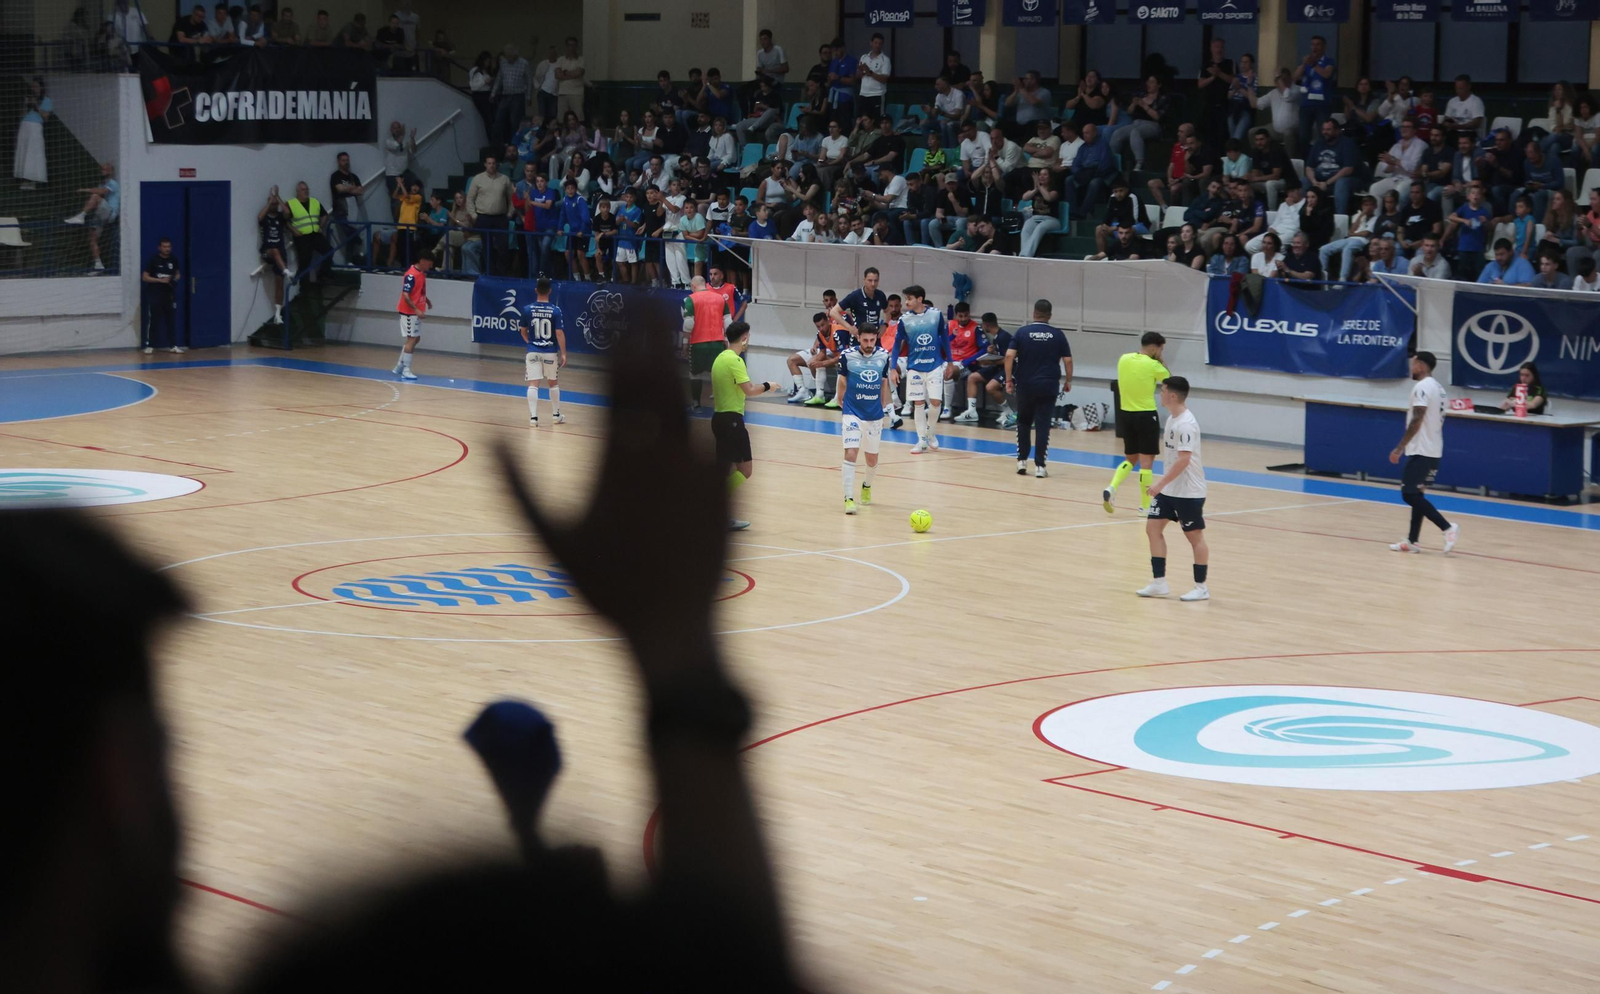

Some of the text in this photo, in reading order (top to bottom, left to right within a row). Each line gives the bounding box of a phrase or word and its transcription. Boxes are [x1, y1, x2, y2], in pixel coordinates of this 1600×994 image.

[195, 82, 372, 122] COFRADEMANÍA
[473, 315, 507, 330] DARO
[531, 318, 552, 340] 10
[1243, 317, 1319, 337] LEXUS
[1341, 320, 1381, 331] JEREZ DE
[1337, 334, 1403, 346] LA FRONTERA
[1559, 334, 1600, 361] NIM
[1515, 386, 1525, 405] 5
